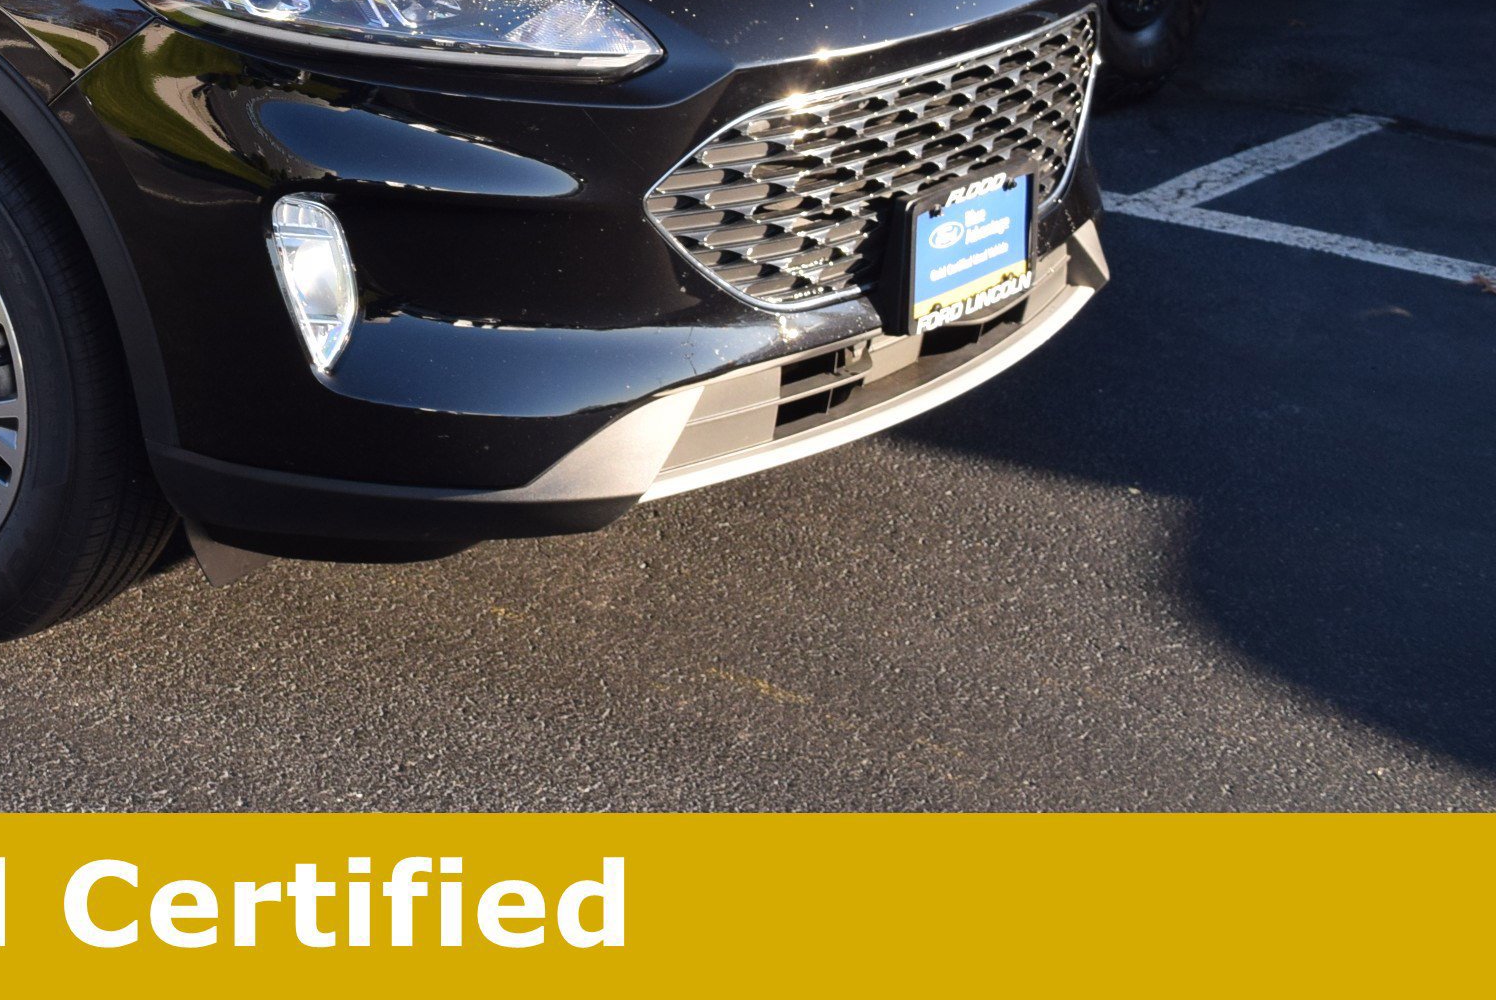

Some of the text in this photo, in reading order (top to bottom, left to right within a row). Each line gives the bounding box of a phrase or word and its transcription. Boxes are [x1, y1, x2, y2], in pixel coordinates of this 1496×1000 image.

[945, 172, 1007, 208] FLOOD
[916, 271, 1033, 335] FORD LINCOLN
